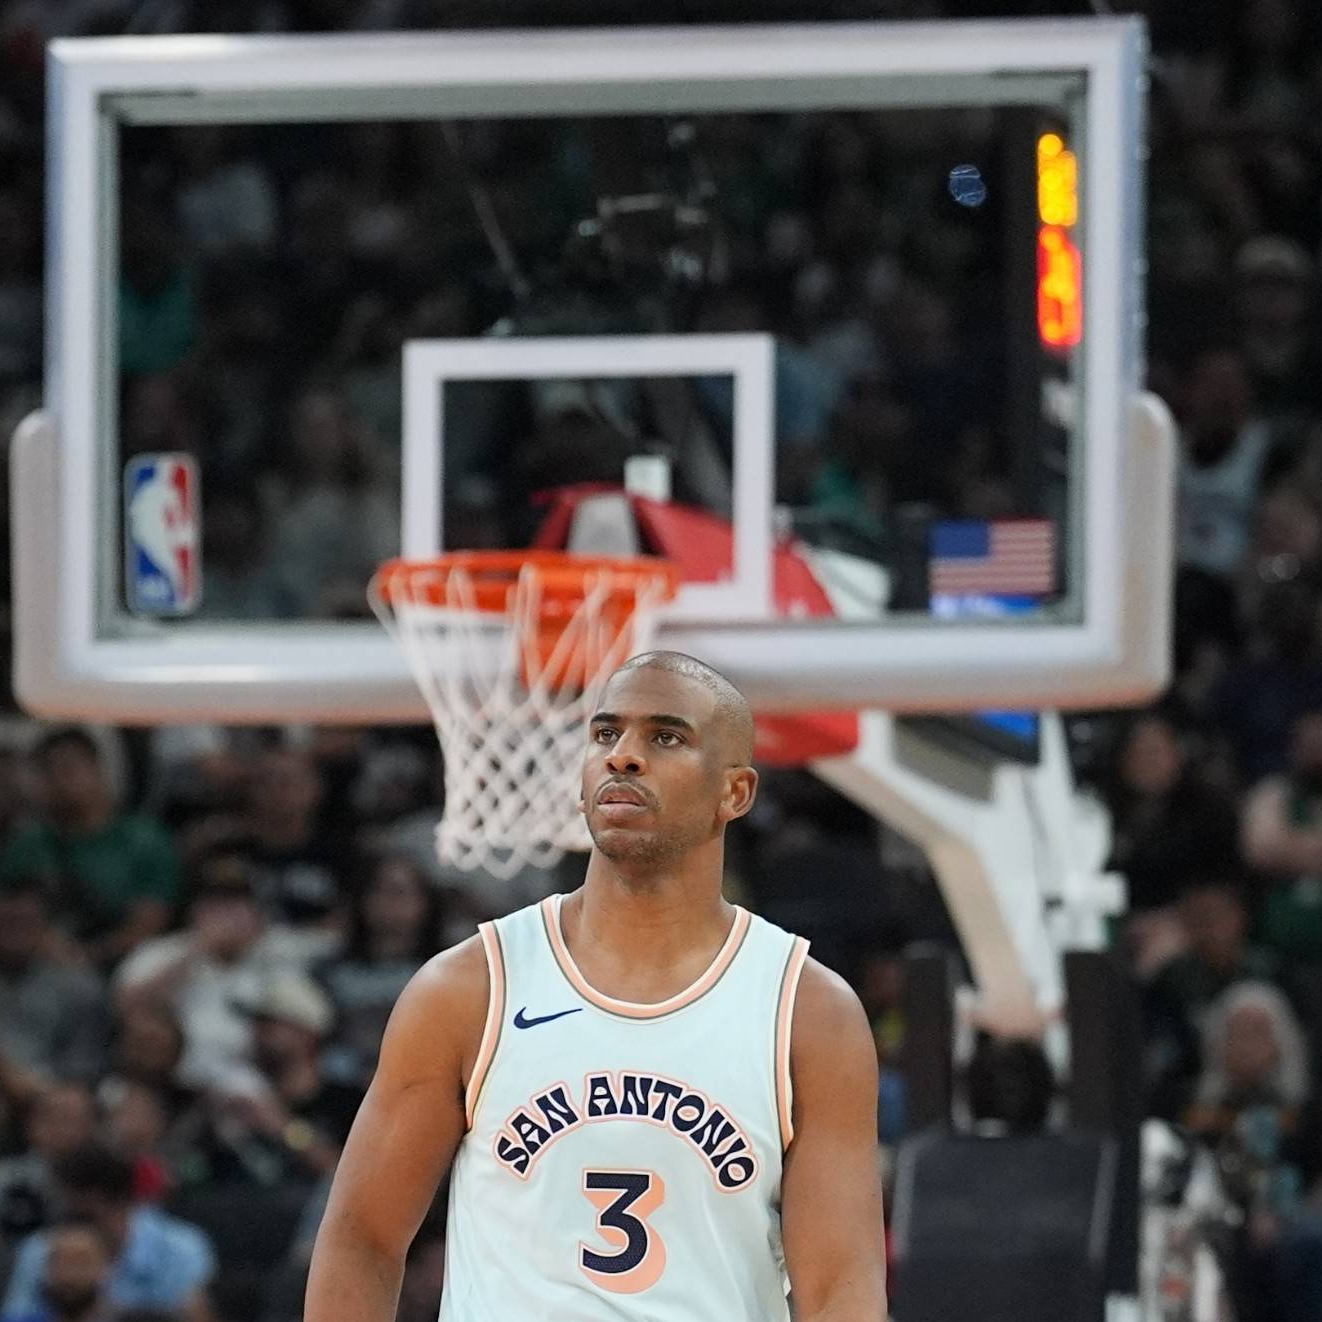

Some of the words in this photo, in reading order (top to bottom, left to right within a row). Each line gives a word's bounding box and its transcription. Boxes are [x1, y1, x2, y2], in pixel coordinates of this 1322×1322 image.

[494, 1084, 581, 1179] SAN
[583, 1073, 758, 1189] ANTONIO
[580, 1169, 660, 1286] 3
